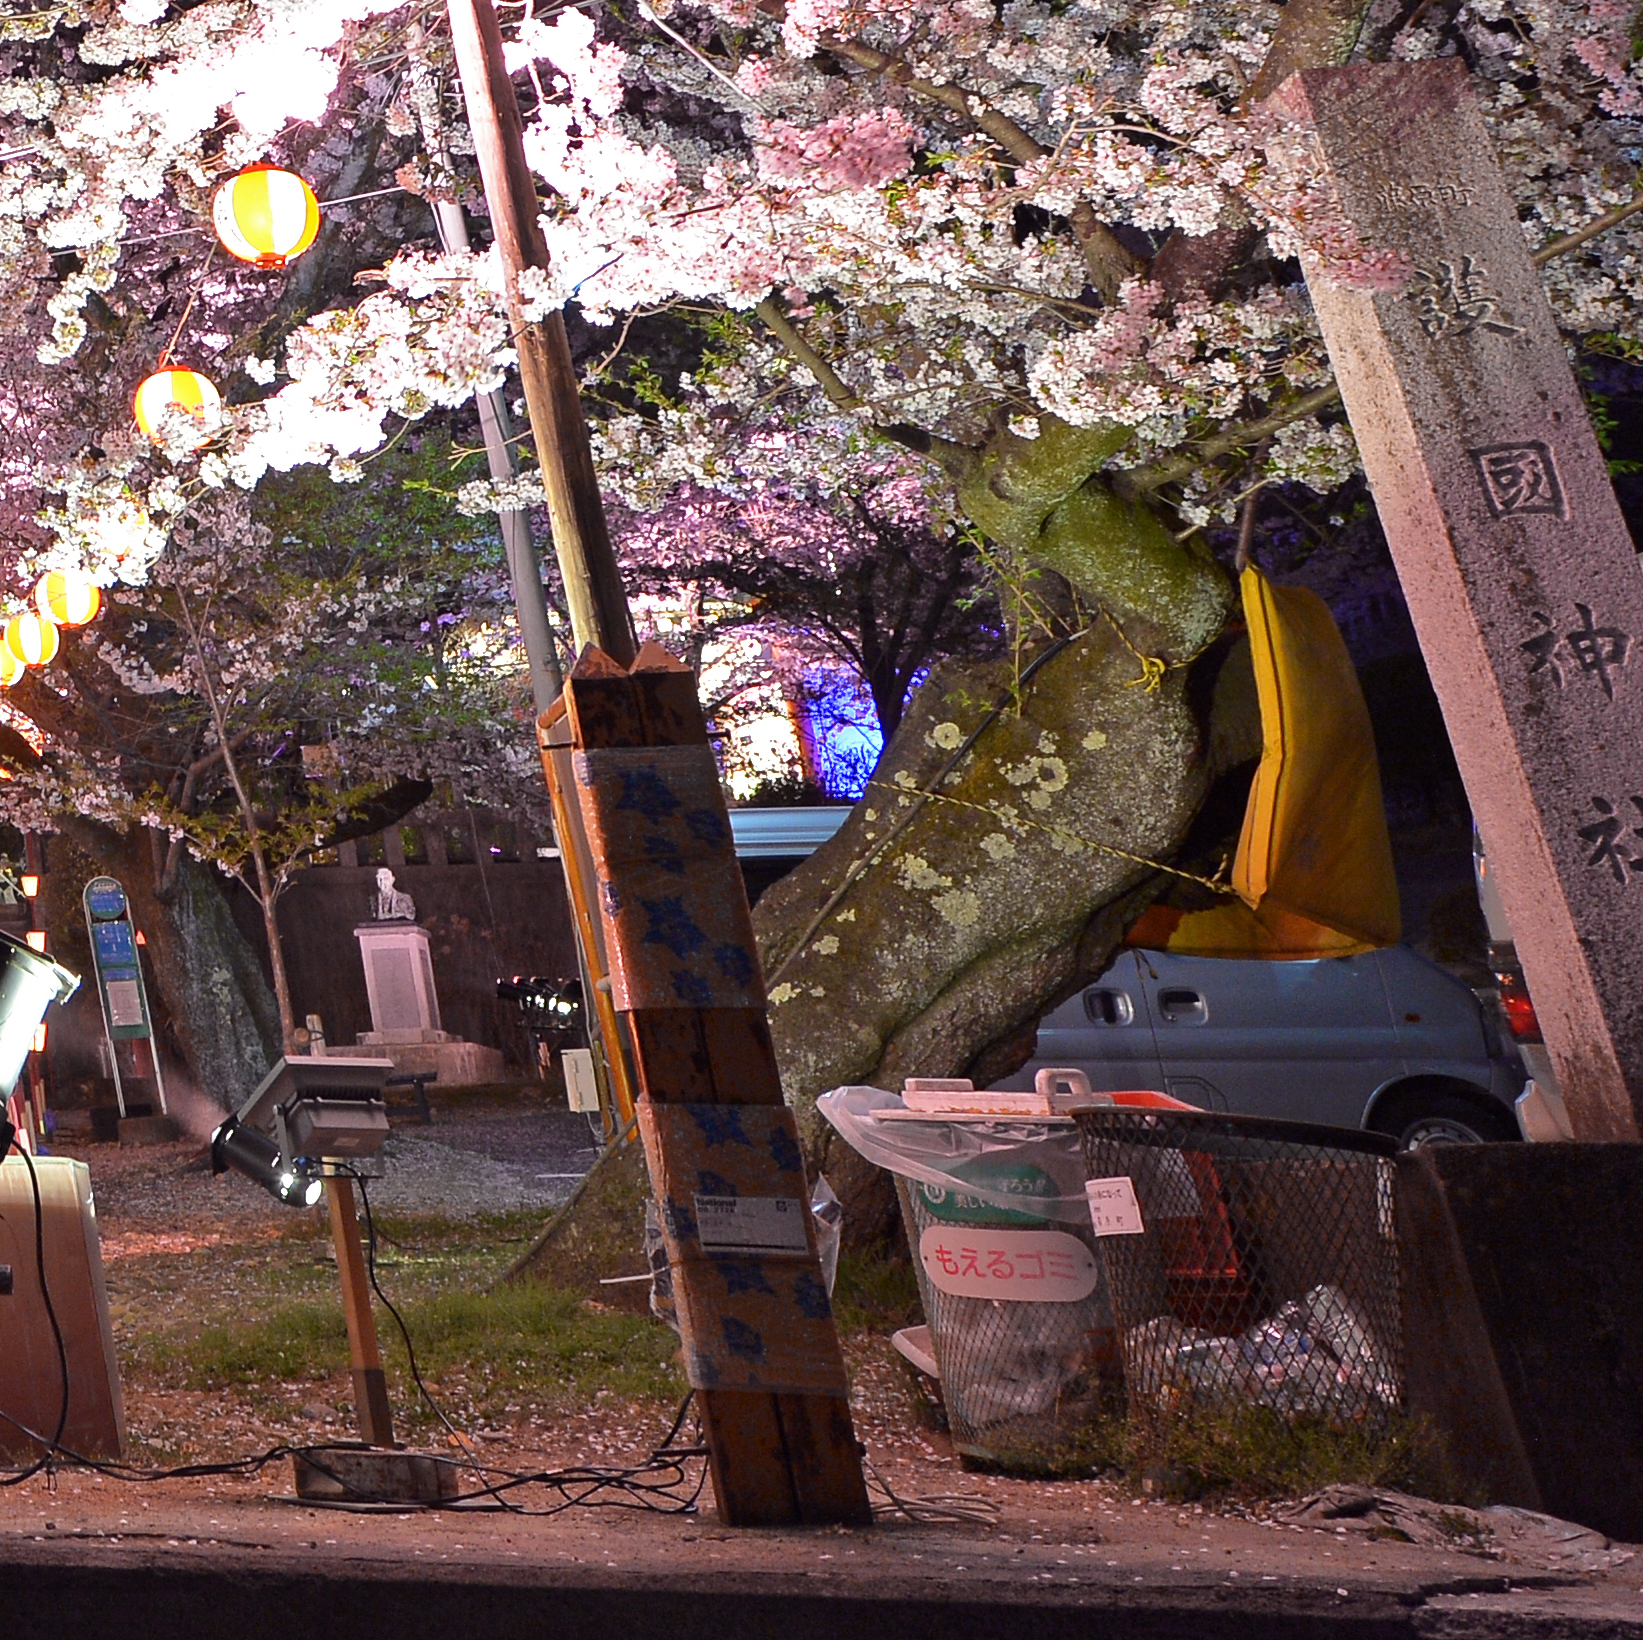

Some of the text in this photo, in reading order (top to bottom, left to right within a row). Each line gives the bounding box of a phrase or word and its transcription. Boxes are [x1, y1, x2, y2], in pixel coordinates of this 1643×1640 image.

[934, 1244, 1080, 1281] もえるゴミ
